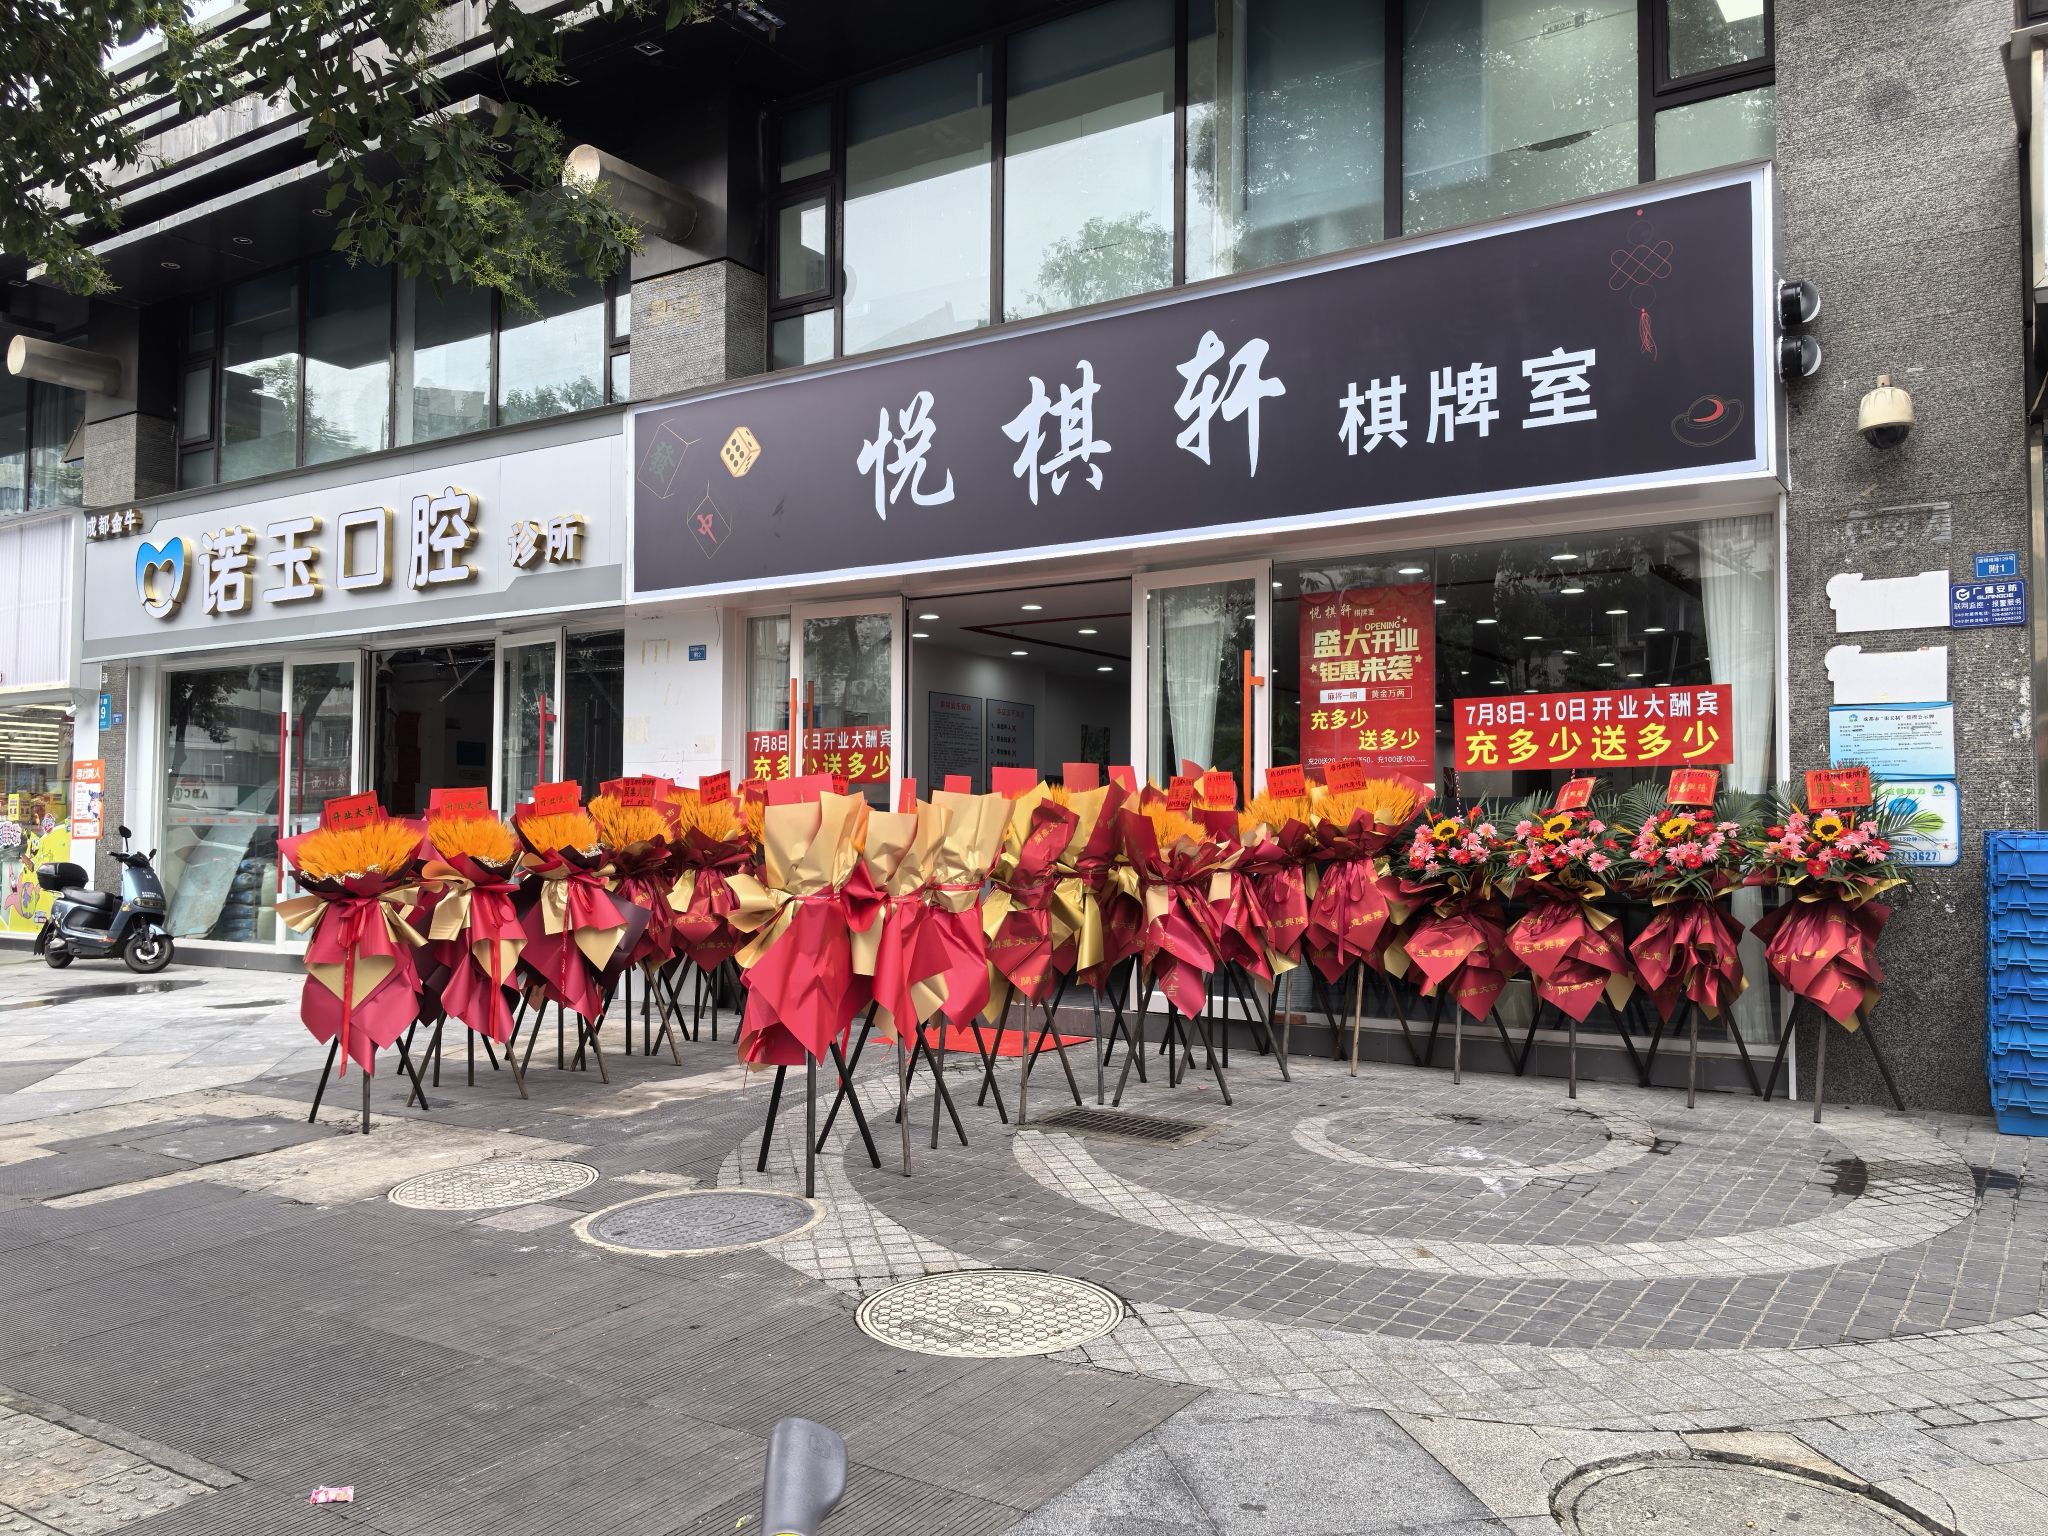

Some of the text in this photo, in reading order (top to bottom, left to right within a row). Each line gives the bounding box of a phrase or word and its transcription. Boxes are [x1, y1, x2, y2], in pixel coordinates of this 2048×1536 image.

[856, 330, 1599, 520] 悦棋轩 棋牌室
[86, 508, 138, 538] 成都金牛
[199, 486, 584, 615] 诺玉口腔 诊所
[1364, 620, 1401, 632] OPENING
[1314, 628, 1420, 659] 盛大开业
[1319, 654, 1414, 683] 钜惠来袭
[1371, 688, 1405, 699] 黄金万两
[1465, 690, 1719, 726] 7月8日-10日开业大酬宾
[1310, 707, 1369, 731] 充多少
[1358, 727, 1421, 751] 送多少
[1465, 720, 1720, 766] 充多少送多少
